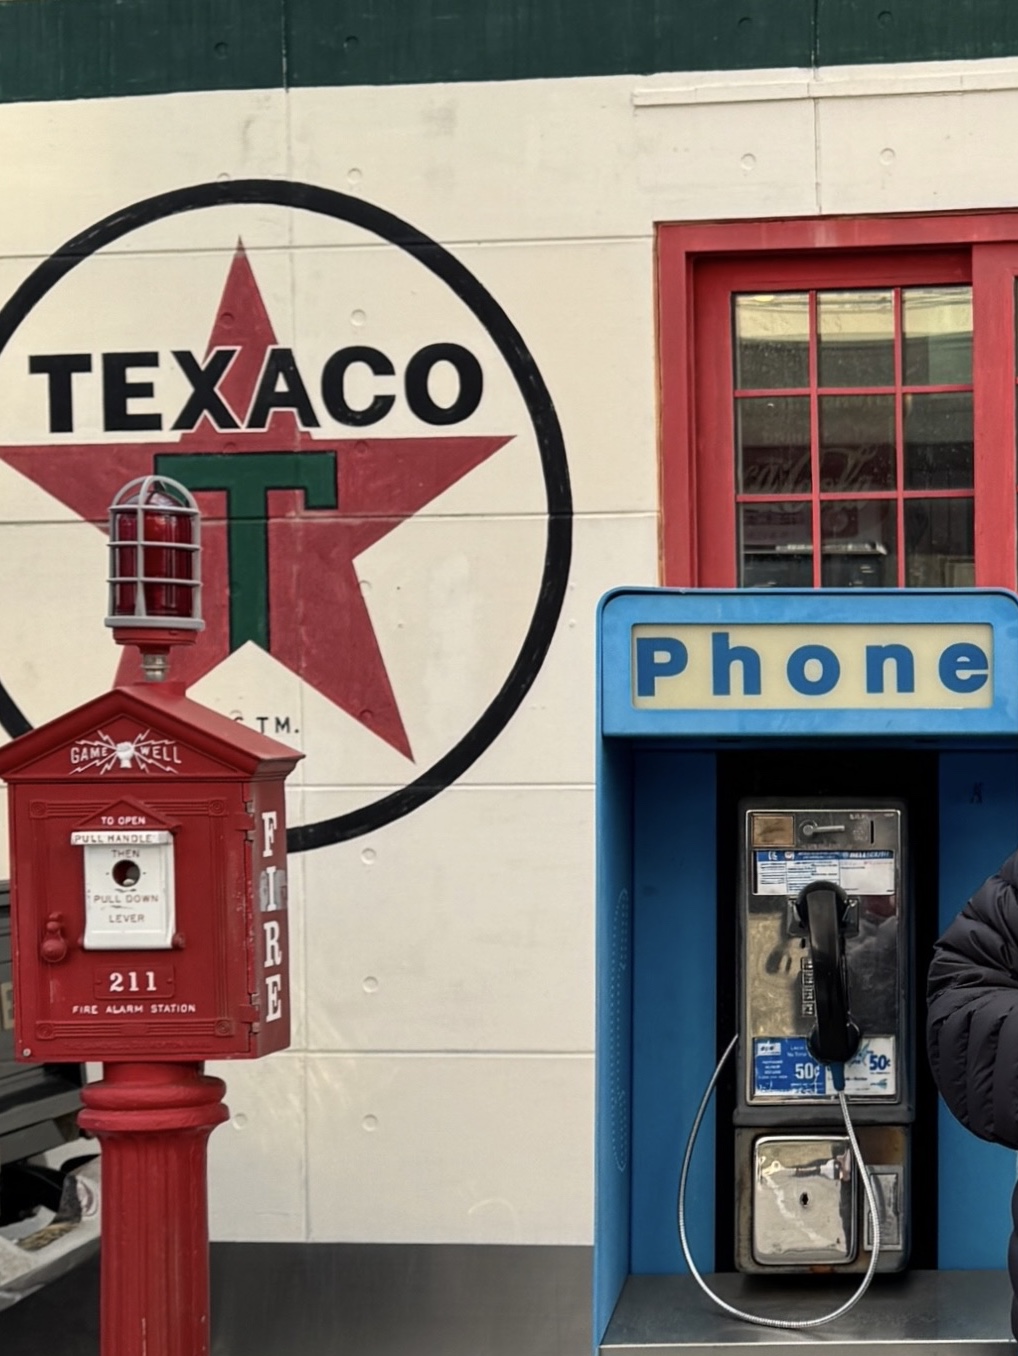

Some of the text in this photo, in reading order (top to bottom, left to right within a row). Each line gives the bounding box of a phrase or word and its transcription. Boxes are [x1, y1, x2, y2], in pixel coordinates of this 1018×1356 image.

[28, 342, 484, 434] TEXACO
[635, 631, 990, 698] Phone
[70, 745, 182, 764] GAME WELL
[101, 816, 147, 826] TO OPEN
[74, 833, 153, 844] PULL HANDLE
[111, 849, 140, 859] THEN
[93, 894, 159, 904] PULL DOWN
[108, 913, 145, 923] LEVER
[261, 810, 283, 1024] FIRE
[109, 970, 158, 993] 211
[72, 1003, 196, 1015] FIRE ALARM STATION
